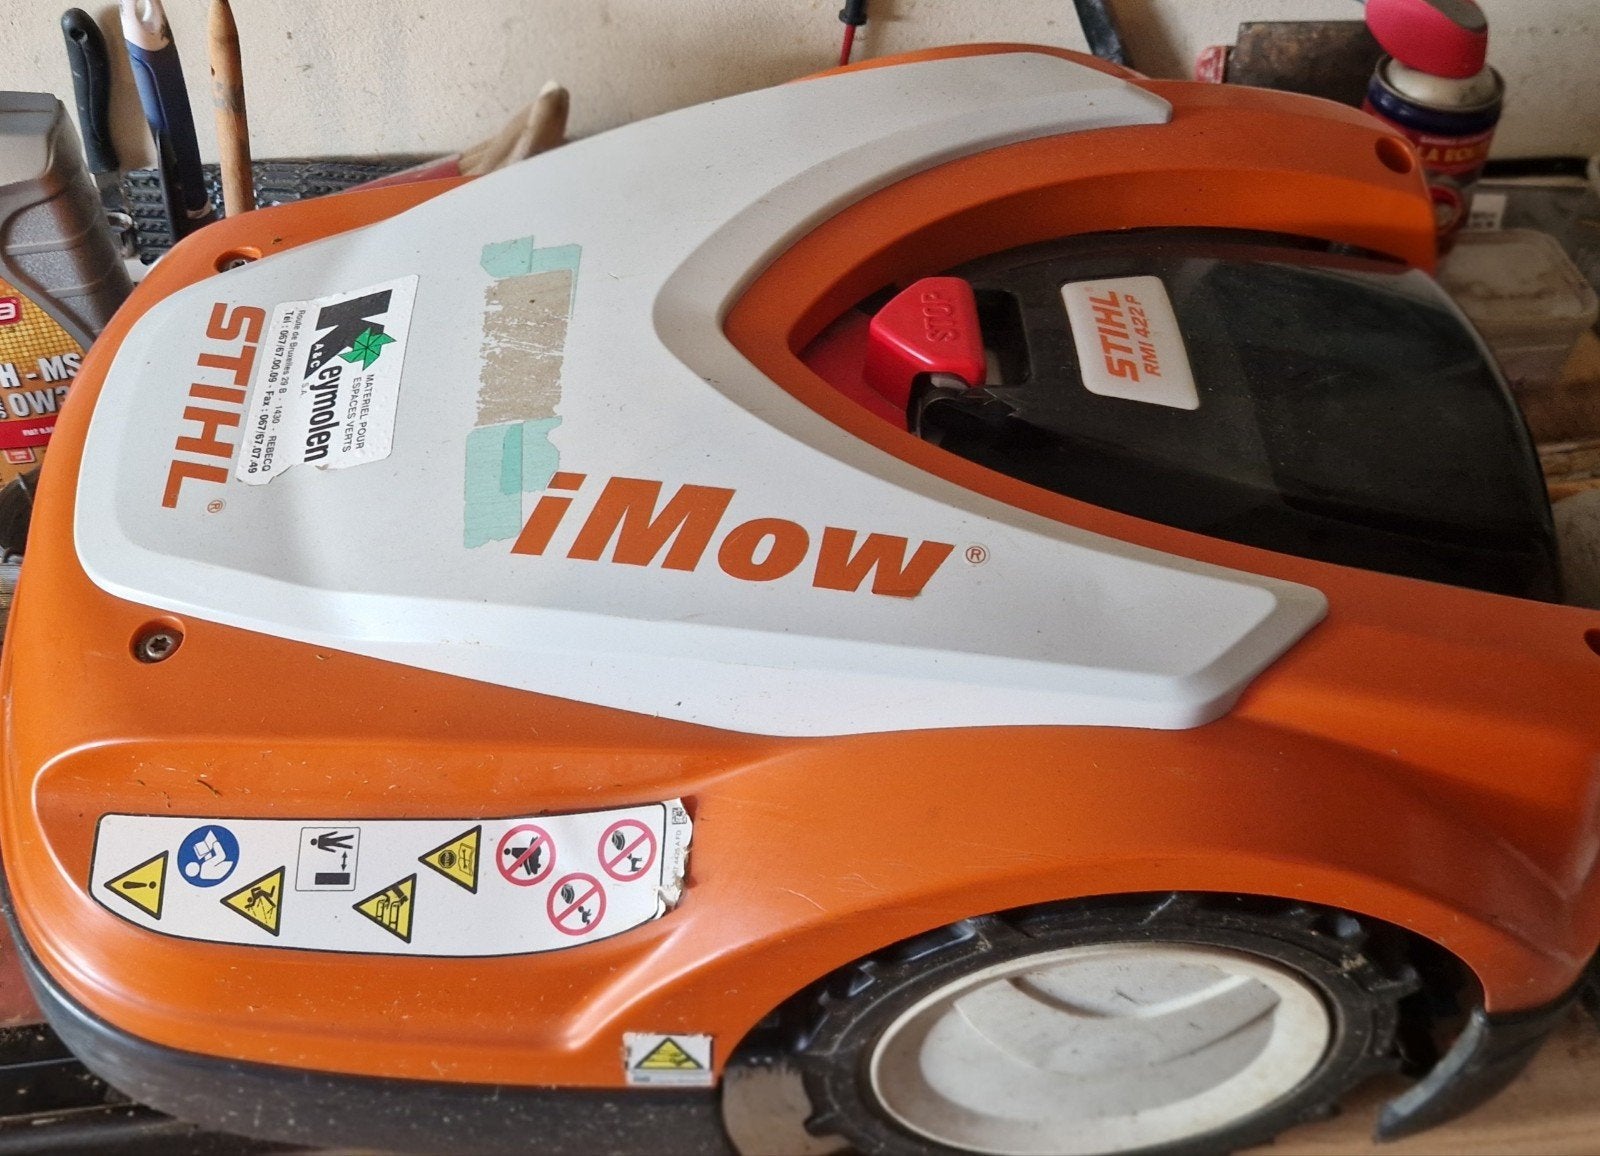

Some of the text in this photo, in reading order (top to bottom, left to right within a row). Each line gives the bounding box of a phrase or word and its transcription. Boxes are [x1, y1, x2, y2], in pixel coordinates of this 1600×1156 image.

[290, 331, 300, 341] de
[293, 309, 306, 330] Route
[921, 292, 954, 343] STOP
[1088, 290, 1140, 383] STIHL
[282, 341, 299, 376] Bruxelles
[1137, 340, 1162, 378] RMI
[162, 302, 266, 509] STIHL
[271, 405, 283, 425] 1430
[342, 376, 362, 453] ESPACES VERTS
[355, 373, 375, 450] MATERIEL POUR
[261, 435, 277, 472] REBECQ
[510, 471, 956, 600] iMow
